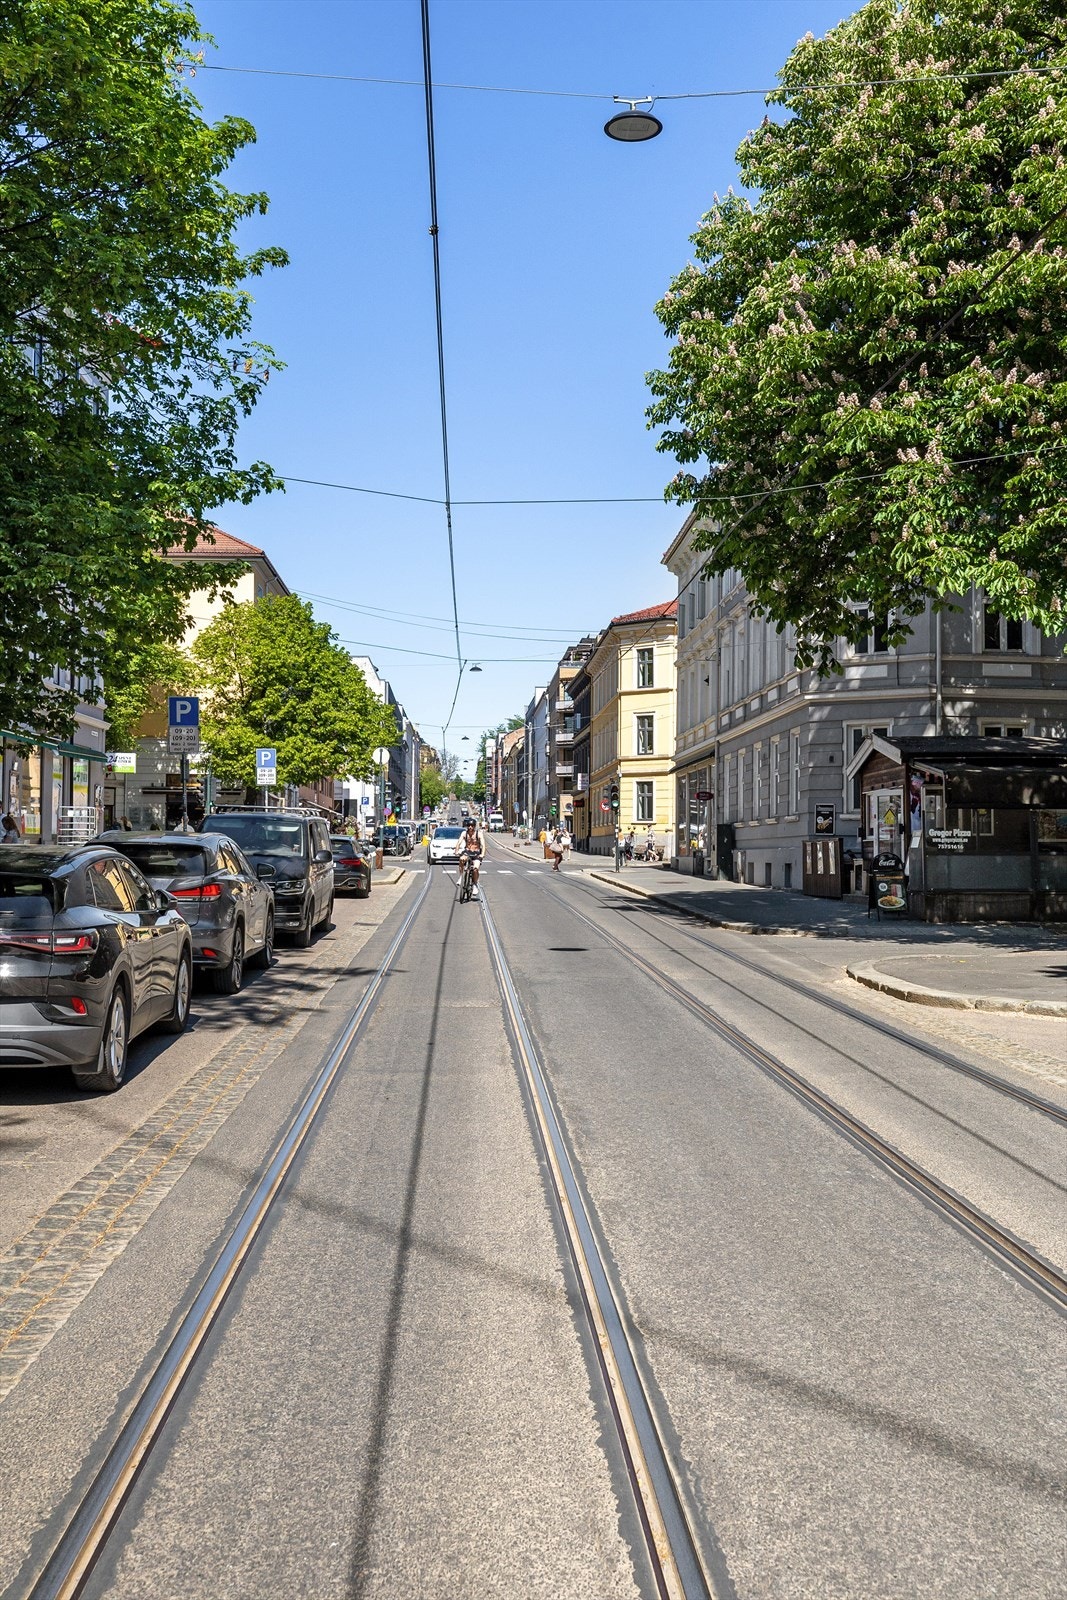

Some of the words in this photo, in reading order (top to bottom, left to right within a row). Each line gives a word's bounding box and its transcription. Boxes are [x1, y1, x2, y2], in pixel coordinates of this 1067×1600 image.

[176, 700, 192, 723] P
[261, 751, 272, 766] P
[928, 828, 952, 838] Gregor
[953, 828, 972, 837] Pizza
